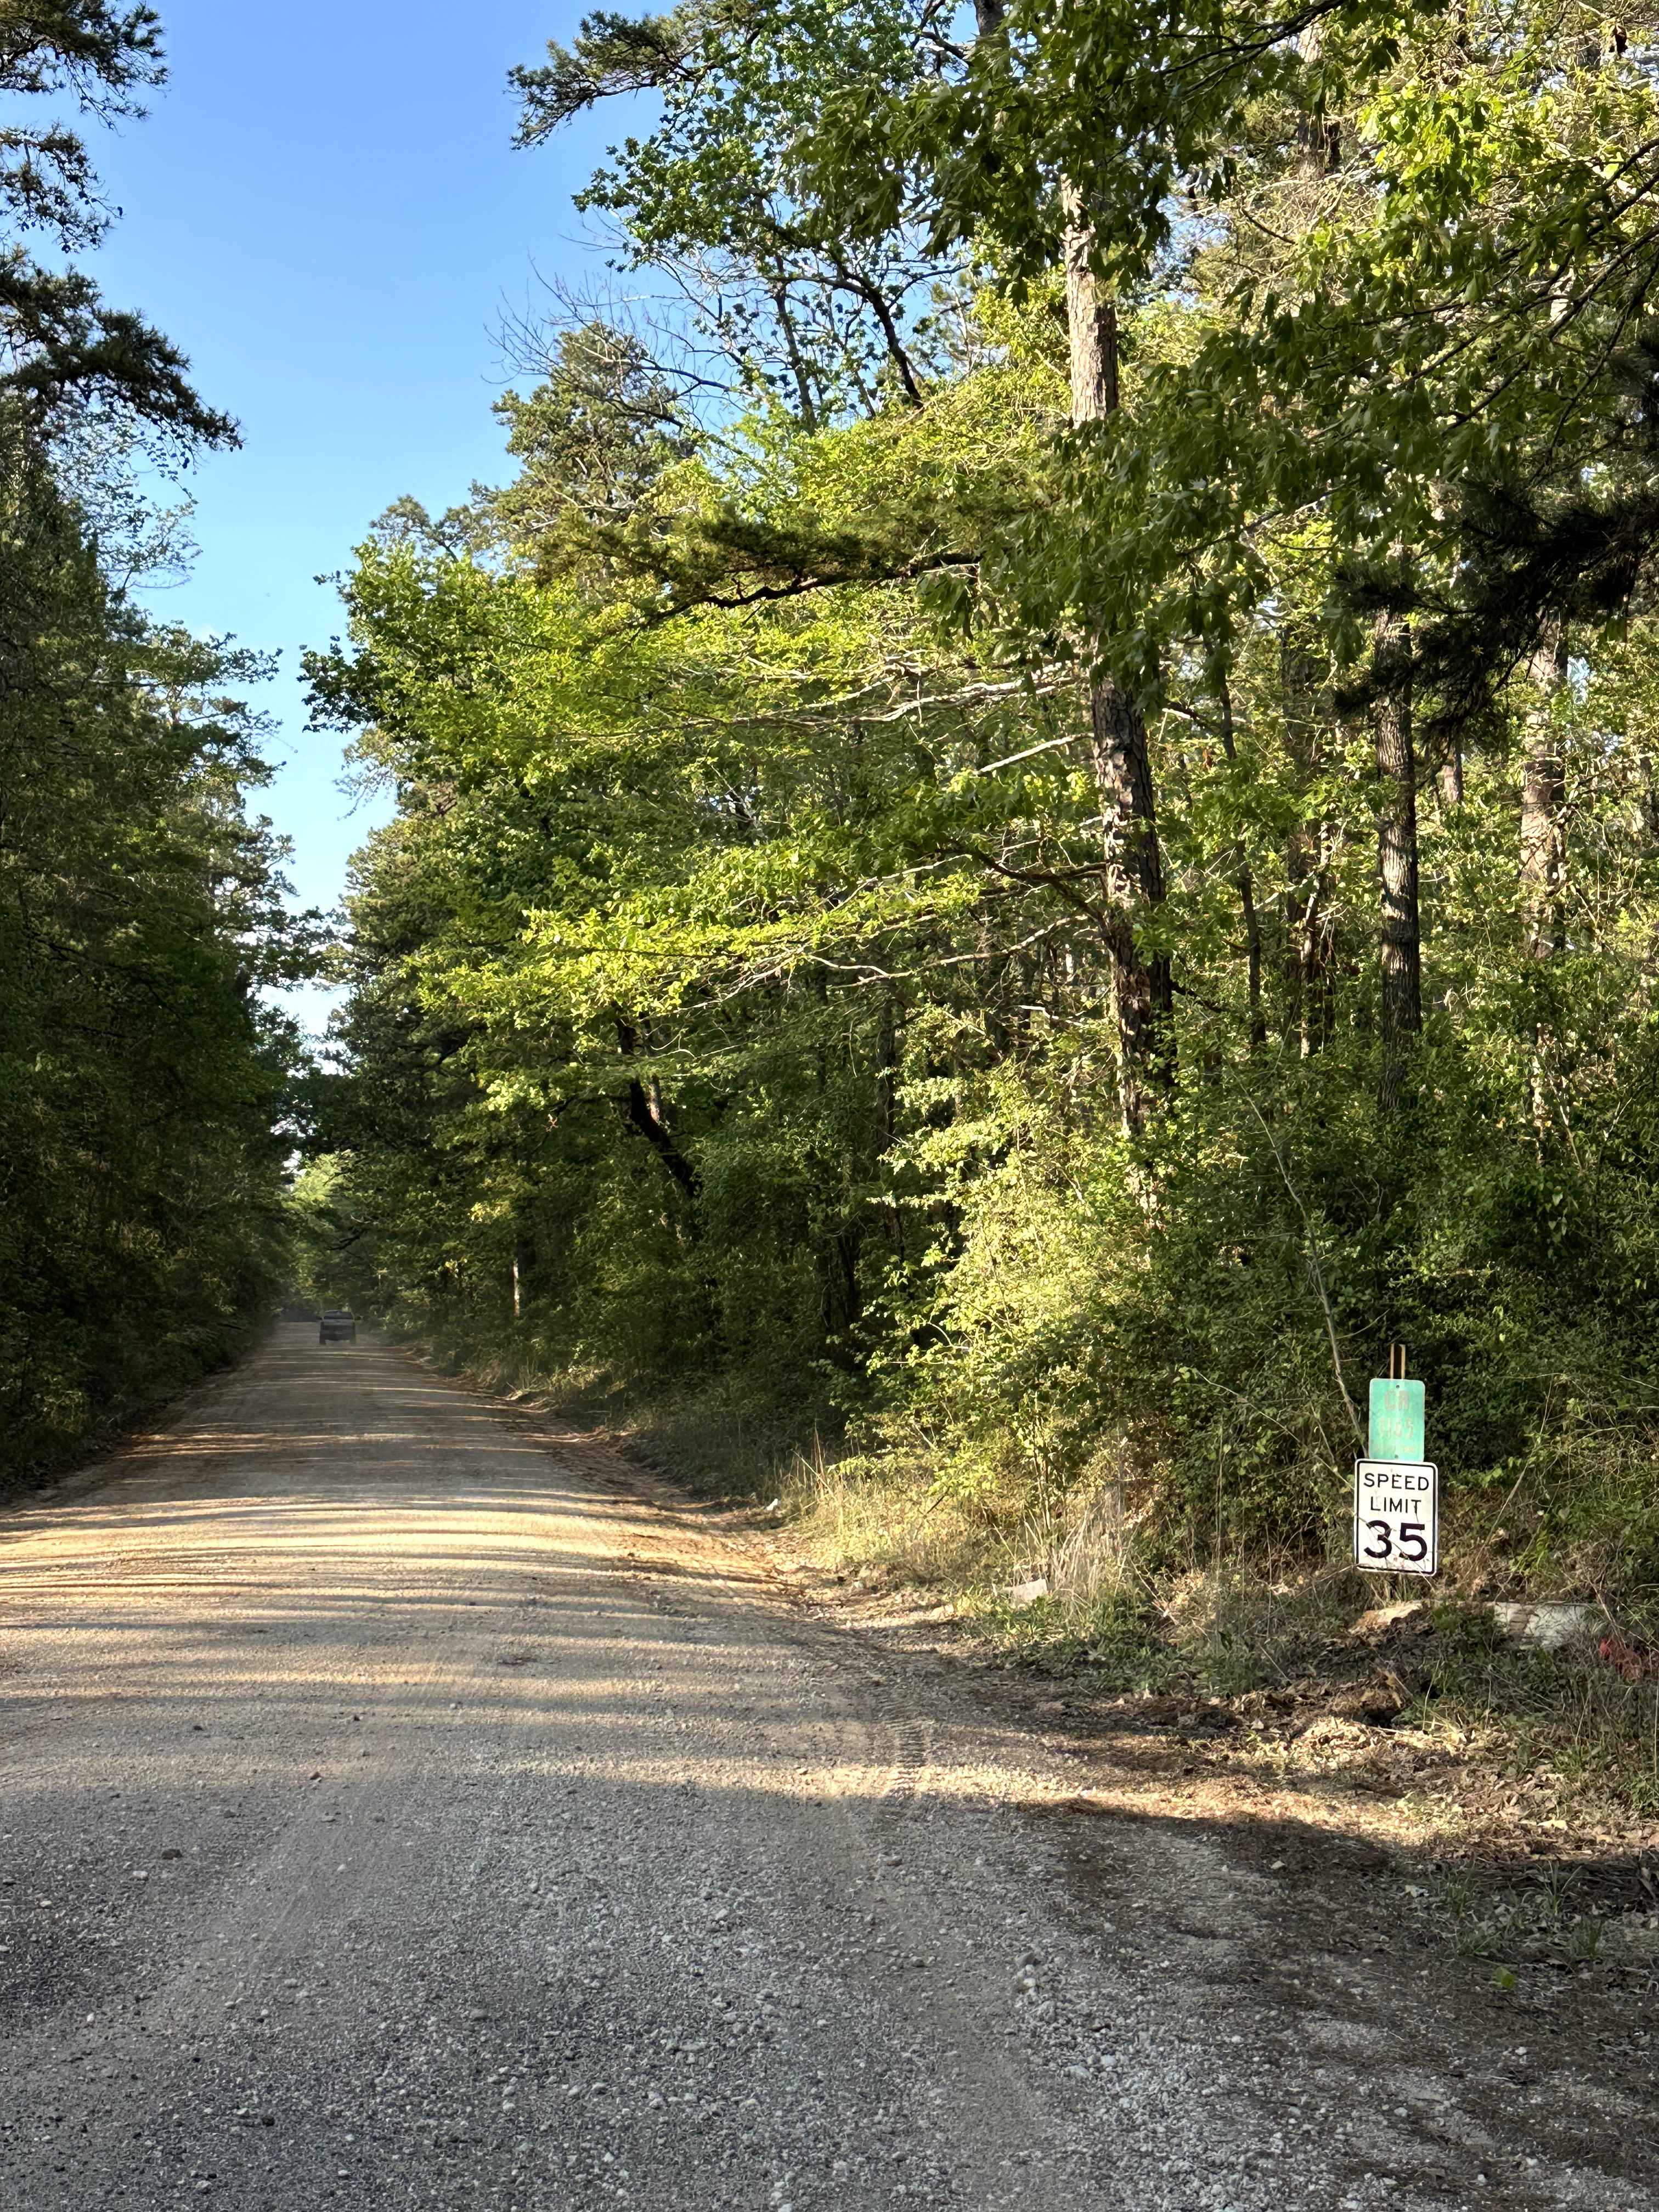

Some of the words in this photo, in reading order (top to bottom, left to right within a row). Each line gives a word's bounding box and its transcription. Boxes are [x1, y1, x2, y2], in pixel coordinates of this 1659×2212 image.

[1364, 1473, 1429, 1491] SPEED
[1370, 1496, 1421, 1514] LIMIT
[1364, 1520, 1427, 1561] 35
